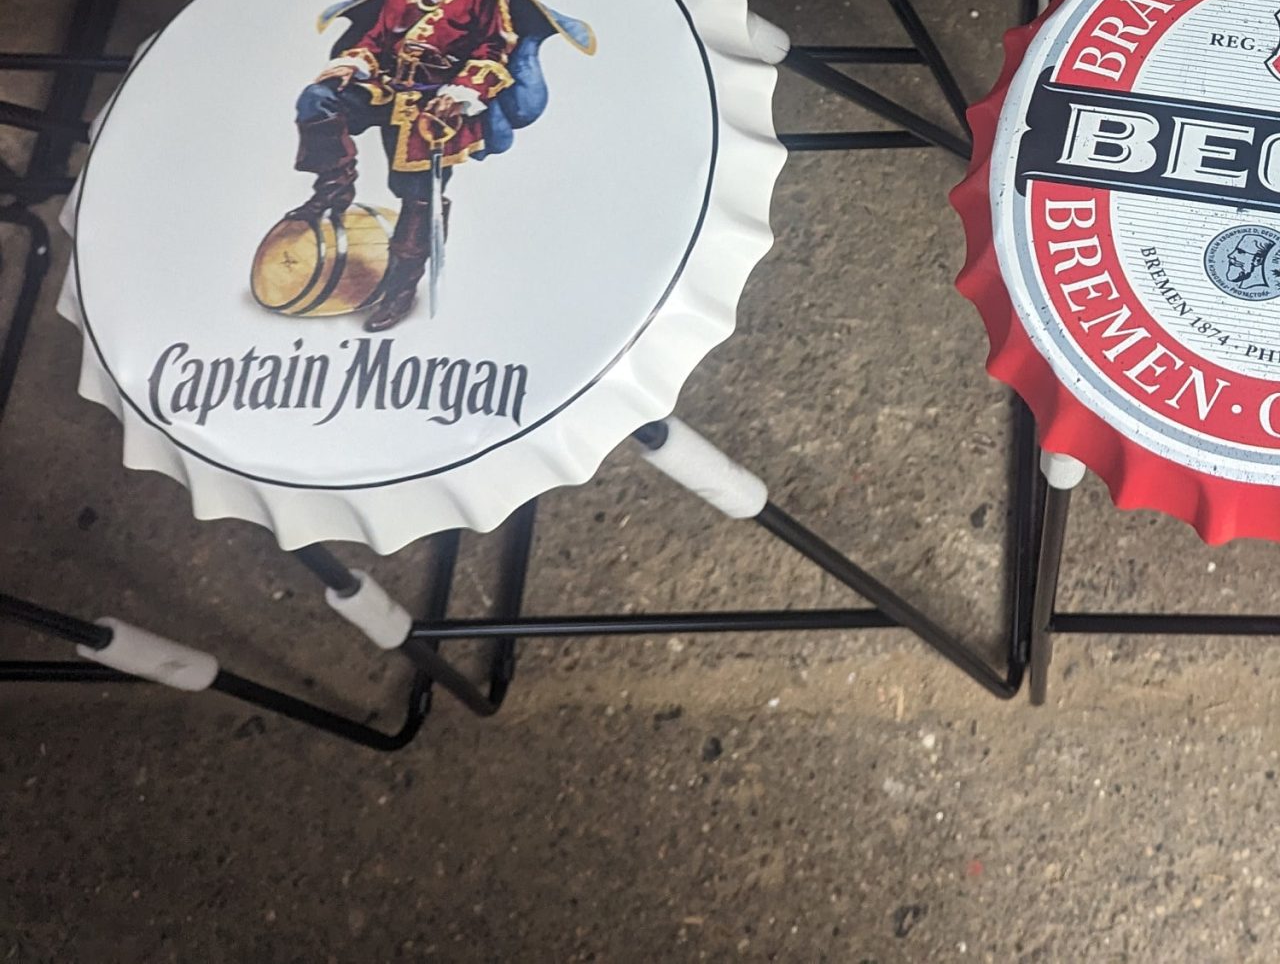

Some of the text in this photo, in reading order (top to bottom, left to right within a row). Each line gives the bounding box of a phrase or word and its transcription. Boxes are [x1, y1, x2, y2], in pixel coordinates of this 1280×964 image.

[1209, 33, 1262, 52] REG.
[1043, 197, 1232, 420] BREMEN
[1141, 247, 1193, 317] BREMEN
[1190, 315, 1231, 346] 1874
[147, 338, 330, 426] Captain
